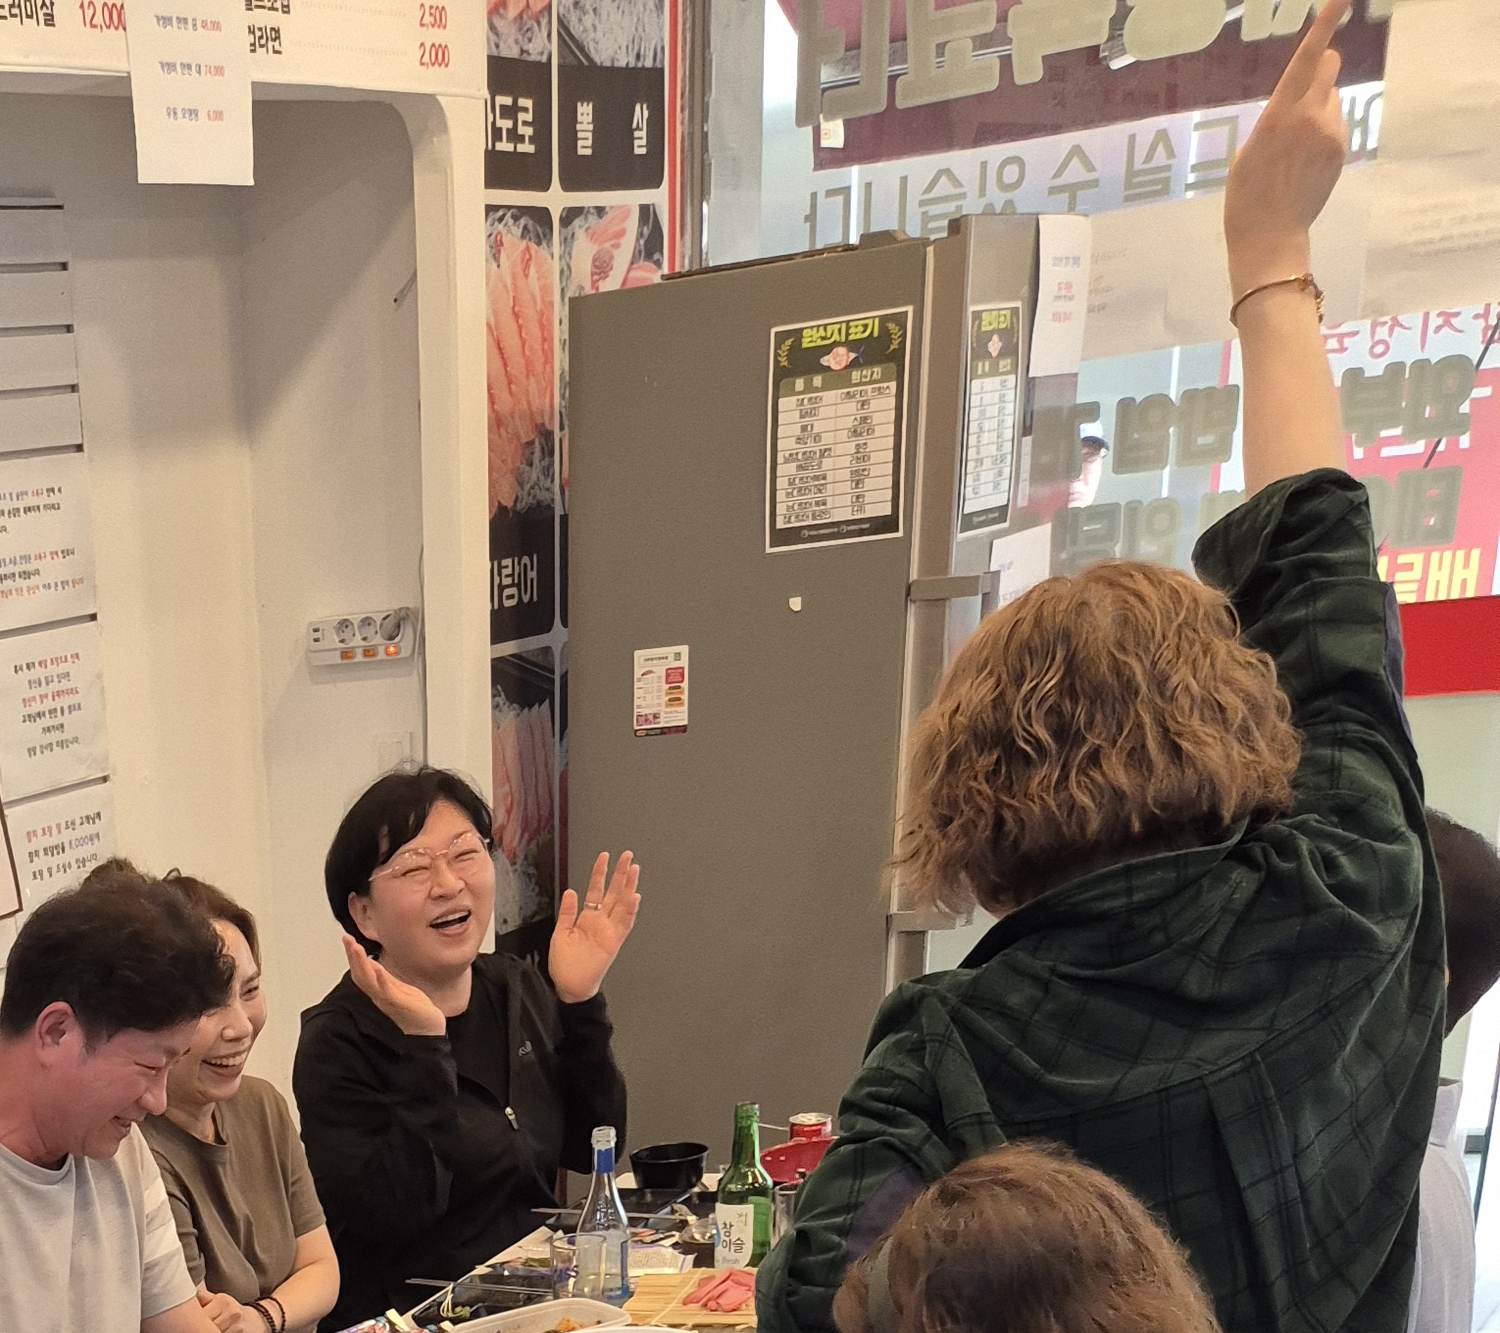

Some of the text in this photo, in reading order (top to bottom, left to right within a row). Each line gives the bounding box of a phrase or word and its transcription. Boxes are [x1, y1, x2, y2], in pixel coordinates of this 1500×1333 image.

[418, 3, 448, 30] 2,500
[418, 43, 450, 69] 2,000
[207, 109, 224, 122] 6,000
[485, 95, 535, 153] 도로
[801, 317, 880, 349] 원산지 표기
[851, 367, 882, 383] 원산지
[721, 1237, 746, 1254] 이슬
